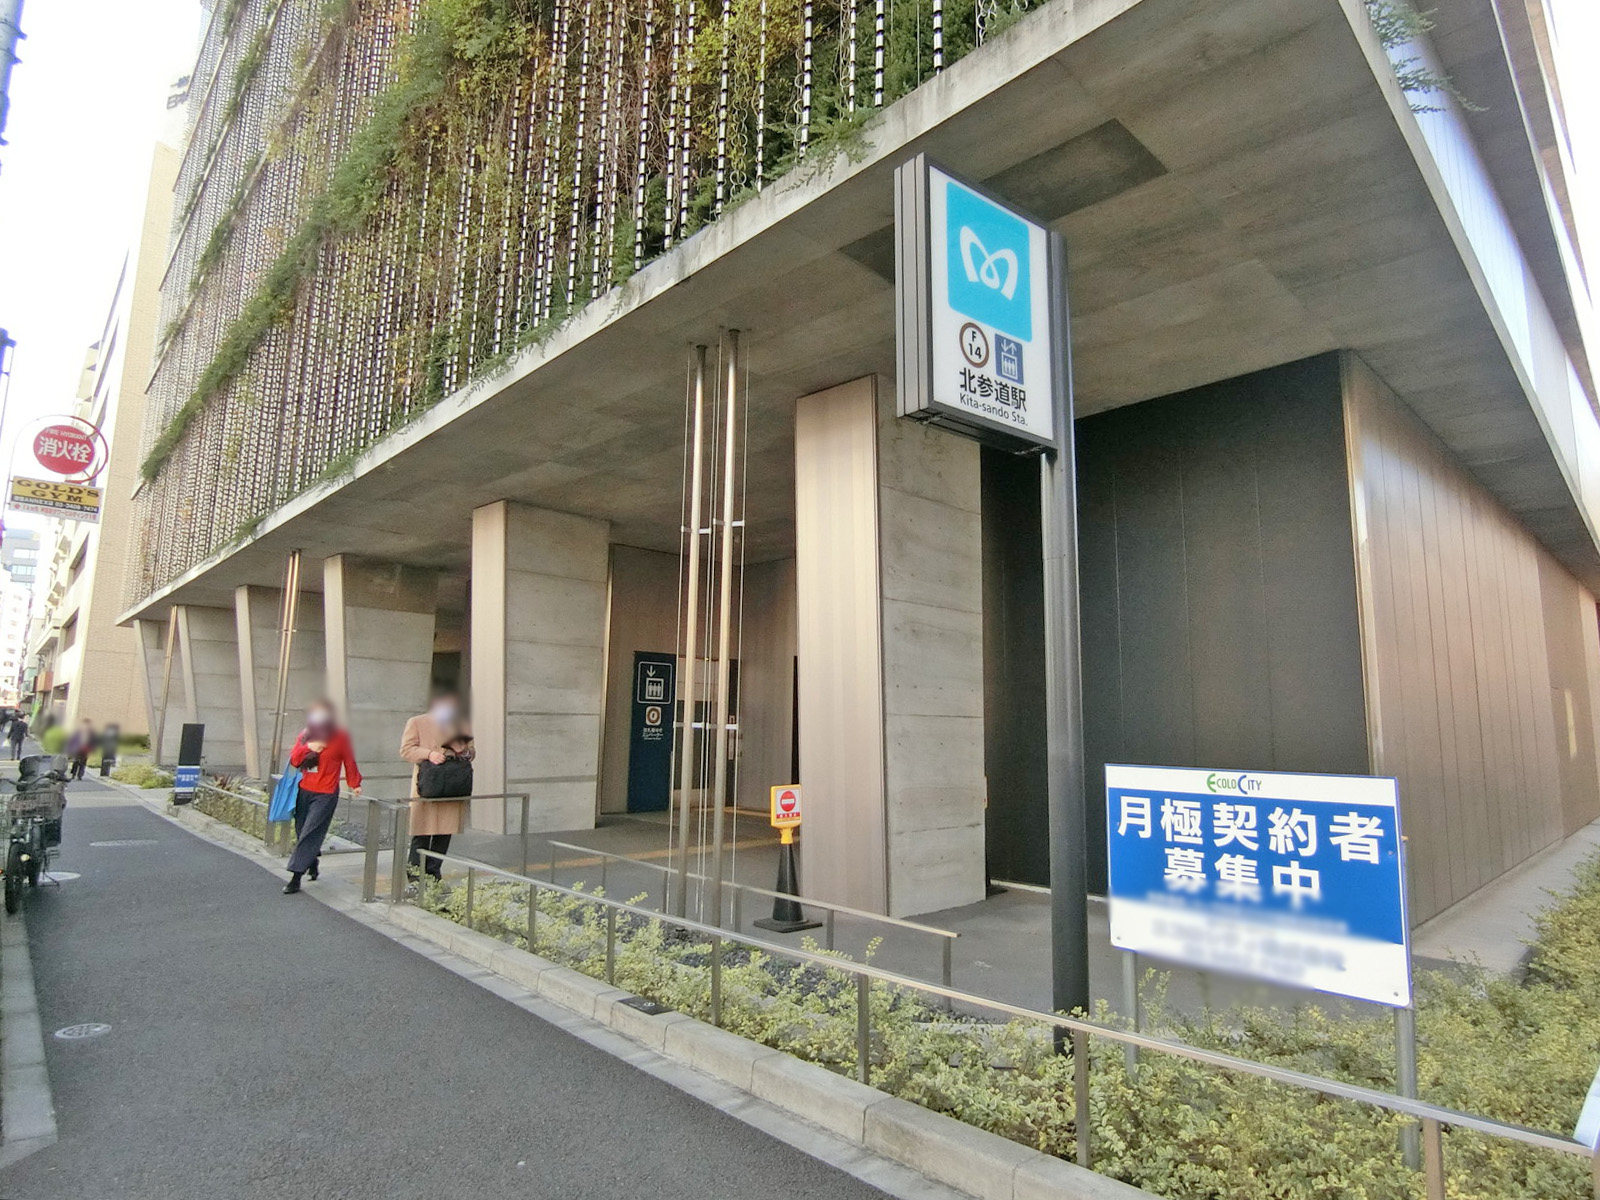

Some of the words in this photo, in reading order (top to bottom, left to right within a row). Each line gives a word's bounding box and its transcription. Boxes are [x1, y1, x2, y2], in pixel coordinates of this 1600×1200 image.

[971, 330, 977, 342] F
[968, 343, 982, 359] 14
[959, 367, 1027, 412] 北参道駅
[959, 393, 1010, 419] Kita-sando
[1011, 411, 1029, 426] Sta.
[38, 436, 91, 464] 消火栓
[16, 479, 99, 498] GOLD'S
[31, 489, 83, 503] GYM
[1117, 795, 1385, 864] 月極契約者
[1161, 847, 1324, 911] 募集中
